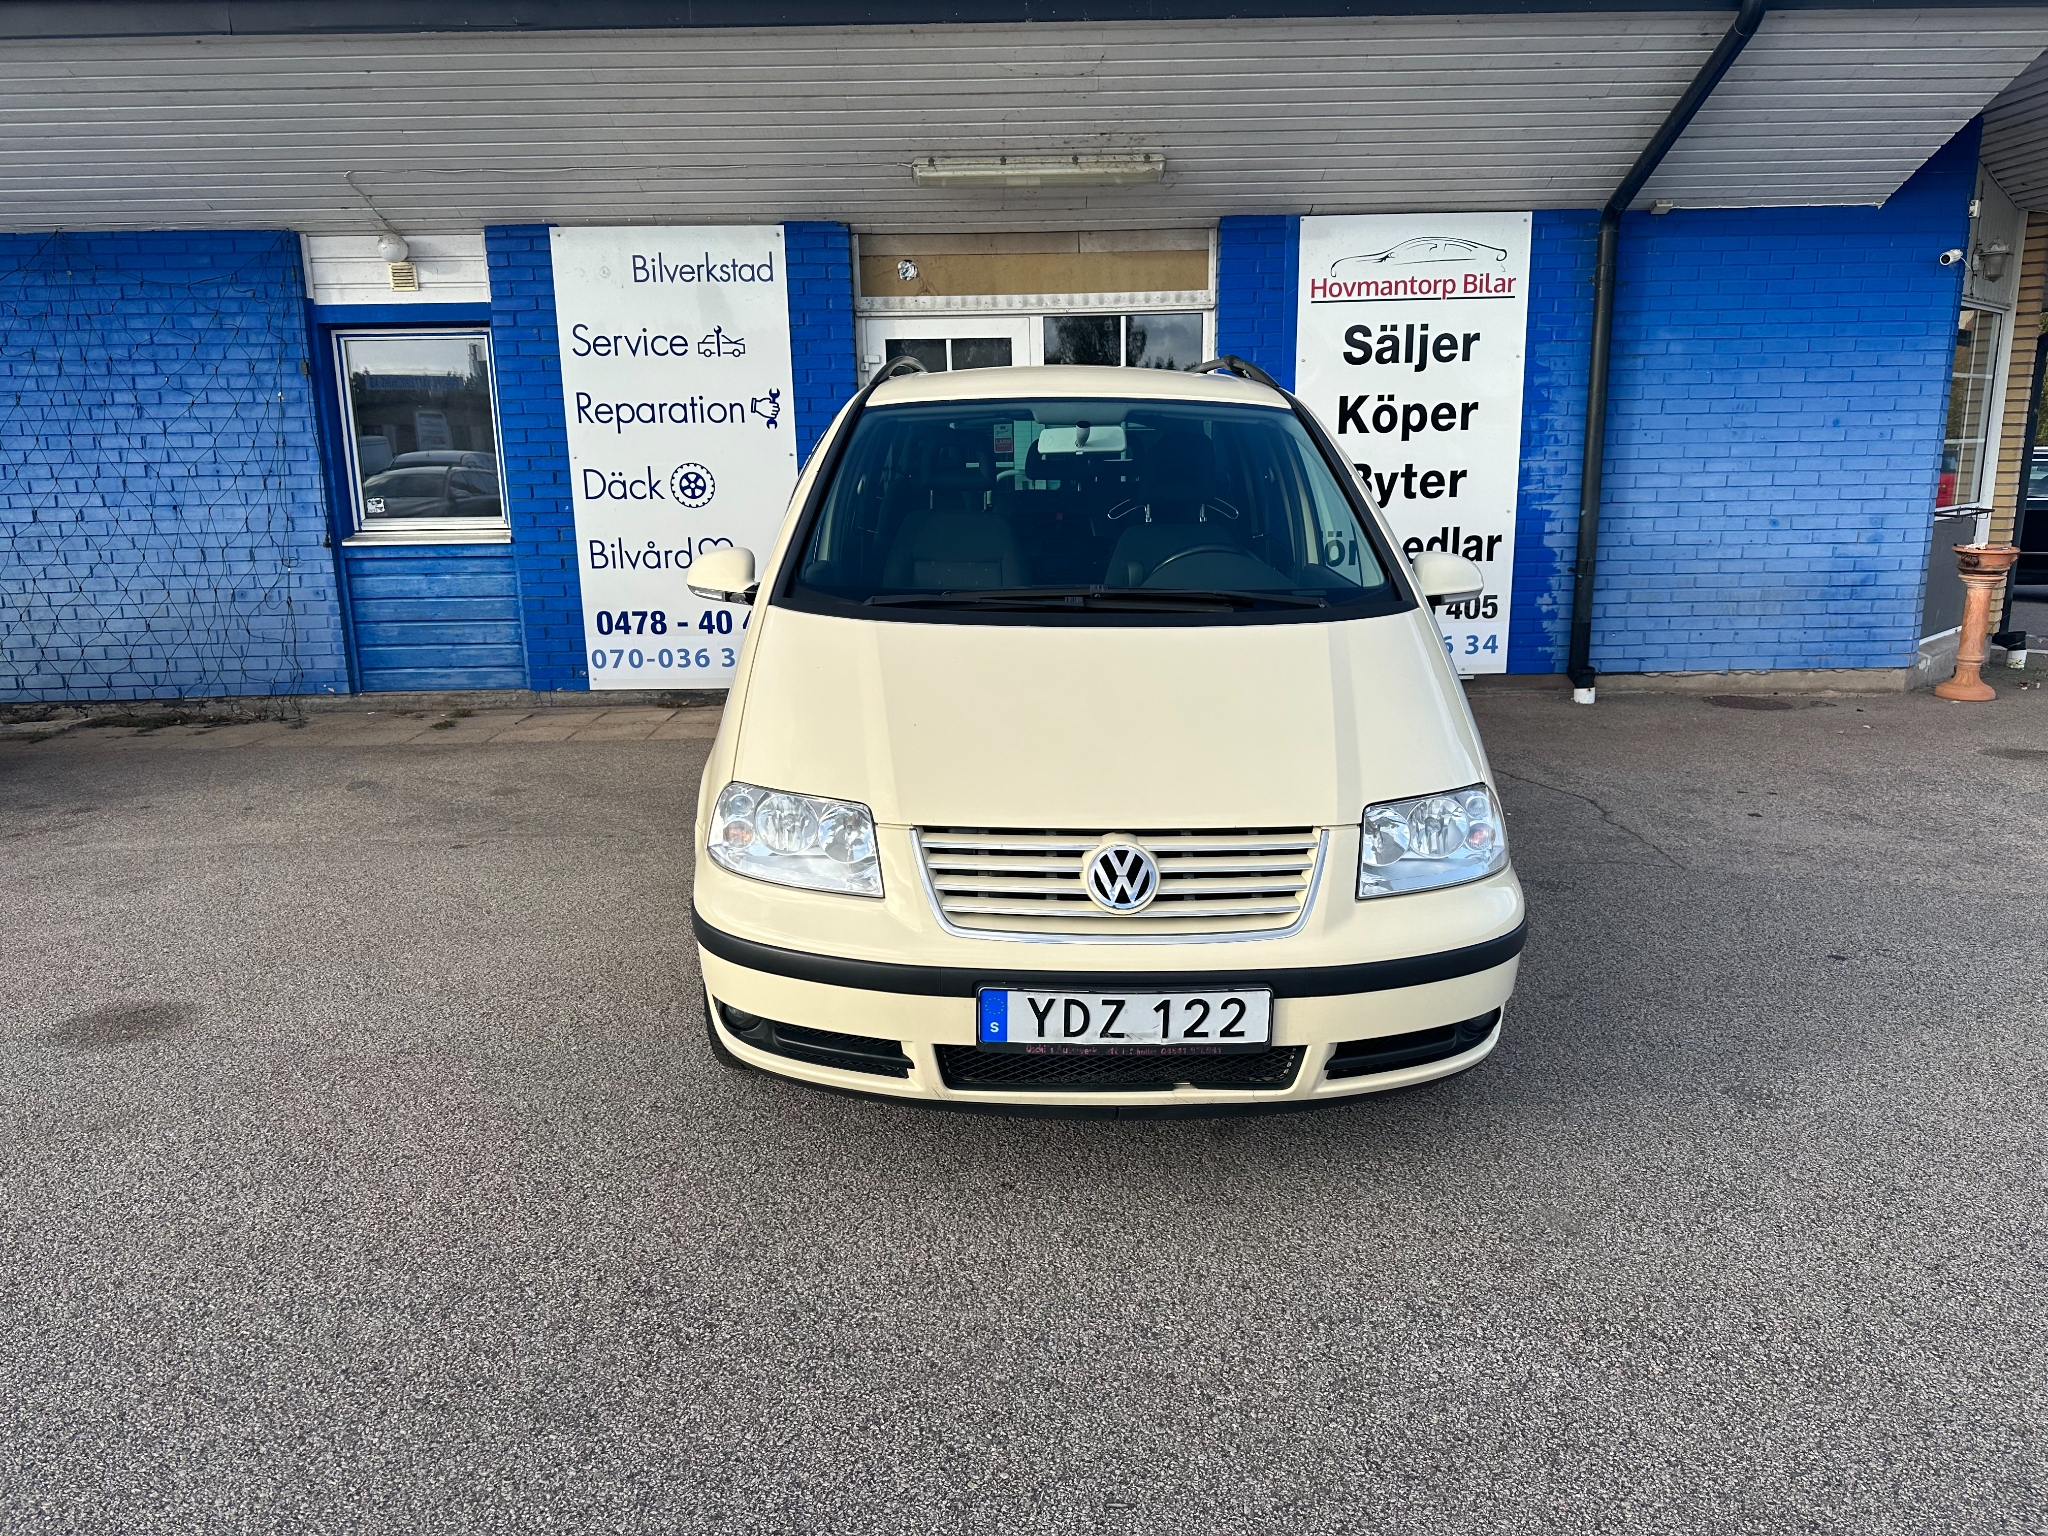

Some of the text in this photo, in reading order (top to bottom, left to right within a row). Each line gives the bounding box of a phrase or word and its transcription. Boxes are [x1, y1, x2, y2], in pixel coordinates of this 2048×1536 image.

[631, 251, 774, 283] Bilverkstad
[1310, 273, 1517, 300] Hovmantorp Bilar
[572, 323, 689, 358] Service
[1342, 323, 1481, 373] Säljer
[575, 391, 746, 434] Reparation
[1337, 394, 1479, 442] Köper
[583, 465, 666, 500] Däck
[589, 536, 693, 570] Bilvård
[596, 610, 667, 636] 0478
[698, 610, 733, 635] 40
[591, 648, 711, 669] 070-036
[1464, 634, 1499, 655] 34
[989, 1021, 1000, 1033] S
[1026, 997, 1247, 1039] YDZ 122
